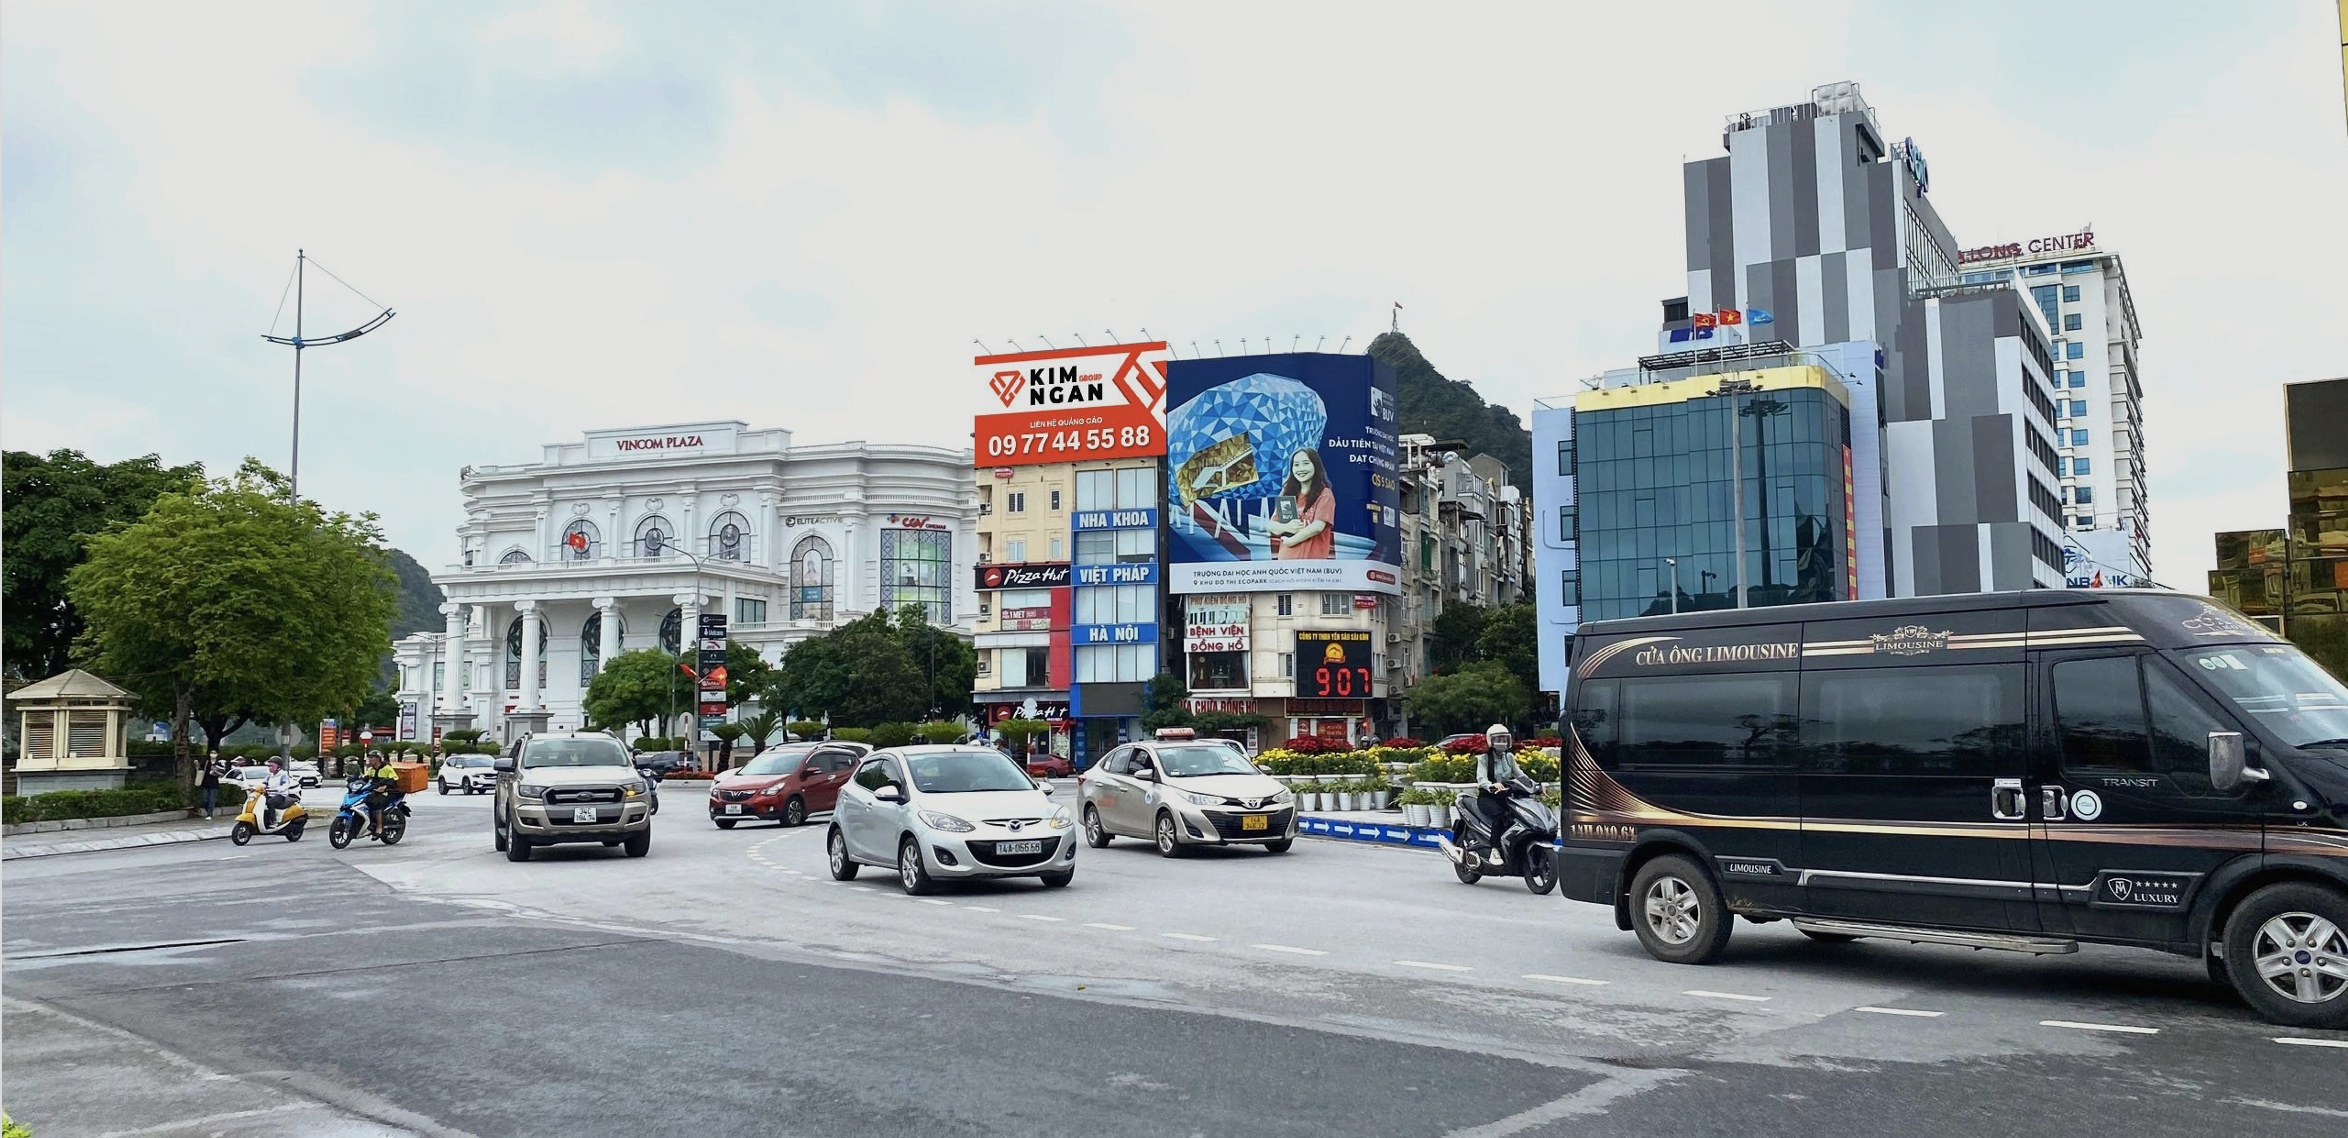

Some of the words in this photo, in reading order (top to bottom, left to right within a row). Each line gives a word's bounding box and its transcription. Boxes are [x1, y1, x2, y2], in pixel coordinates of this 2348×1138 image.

[2028, 232, 2094, 253] CENTER
[1030, 366, 1077, 386] KIM
[1079, 374, 1102, 382] GROUP
[1030, 383, 1103, 405] NGAN
[1030, 420, 1046, 428] LIÊN
[616, 438, 664, 451] VINCOM
[666, 435, 704, 448] PLAZA
[988, 435, 1017, 456] 09
[1020, 433, 1049, 454] 77
[1052, 430, 1080, 451] 44
[1086, 428, 1114, 450] 55
[1120, 425, 1150, 447] 88
[1349, 454, 1367, 465] ĐẠT
[902, 517, 926, 528] CGV
[1080, 513, 1108, 528] NHA
[1113, 511, 1149, 526] KHOA
[1004, 569, 1041, 585] Pizza
[1042, 568, 1069, 581] Hut
[1080, 565, 1108, 585] VIỆT
[1113, 564, 1149, 581] PHÁP
[1090, 624, 1108, 641] HÀ
[1115, 624, 1138, 643] NỘI
[1190, 625, 1215, 638] BỆNH
[1220, 624, 1244, 637] VIỆN
[1191, 638, 1223, 651] ĐỒNG
[1228, 637, 1243, 650] HỒ
[1875, 641, 1943, 651] LIMOUSINE
[1636, 646, 1665, 666] CỬA
[1669, 645, 1702, 664] ÔNG
[1706, 643, 1799, 662] LIMOUSINE
[2102, 778, 2159, 787] TRANSIT
[1730, 863, 1772, 874] LIMOUSINE
[2134, 893, 2178, 903] LUXURY
